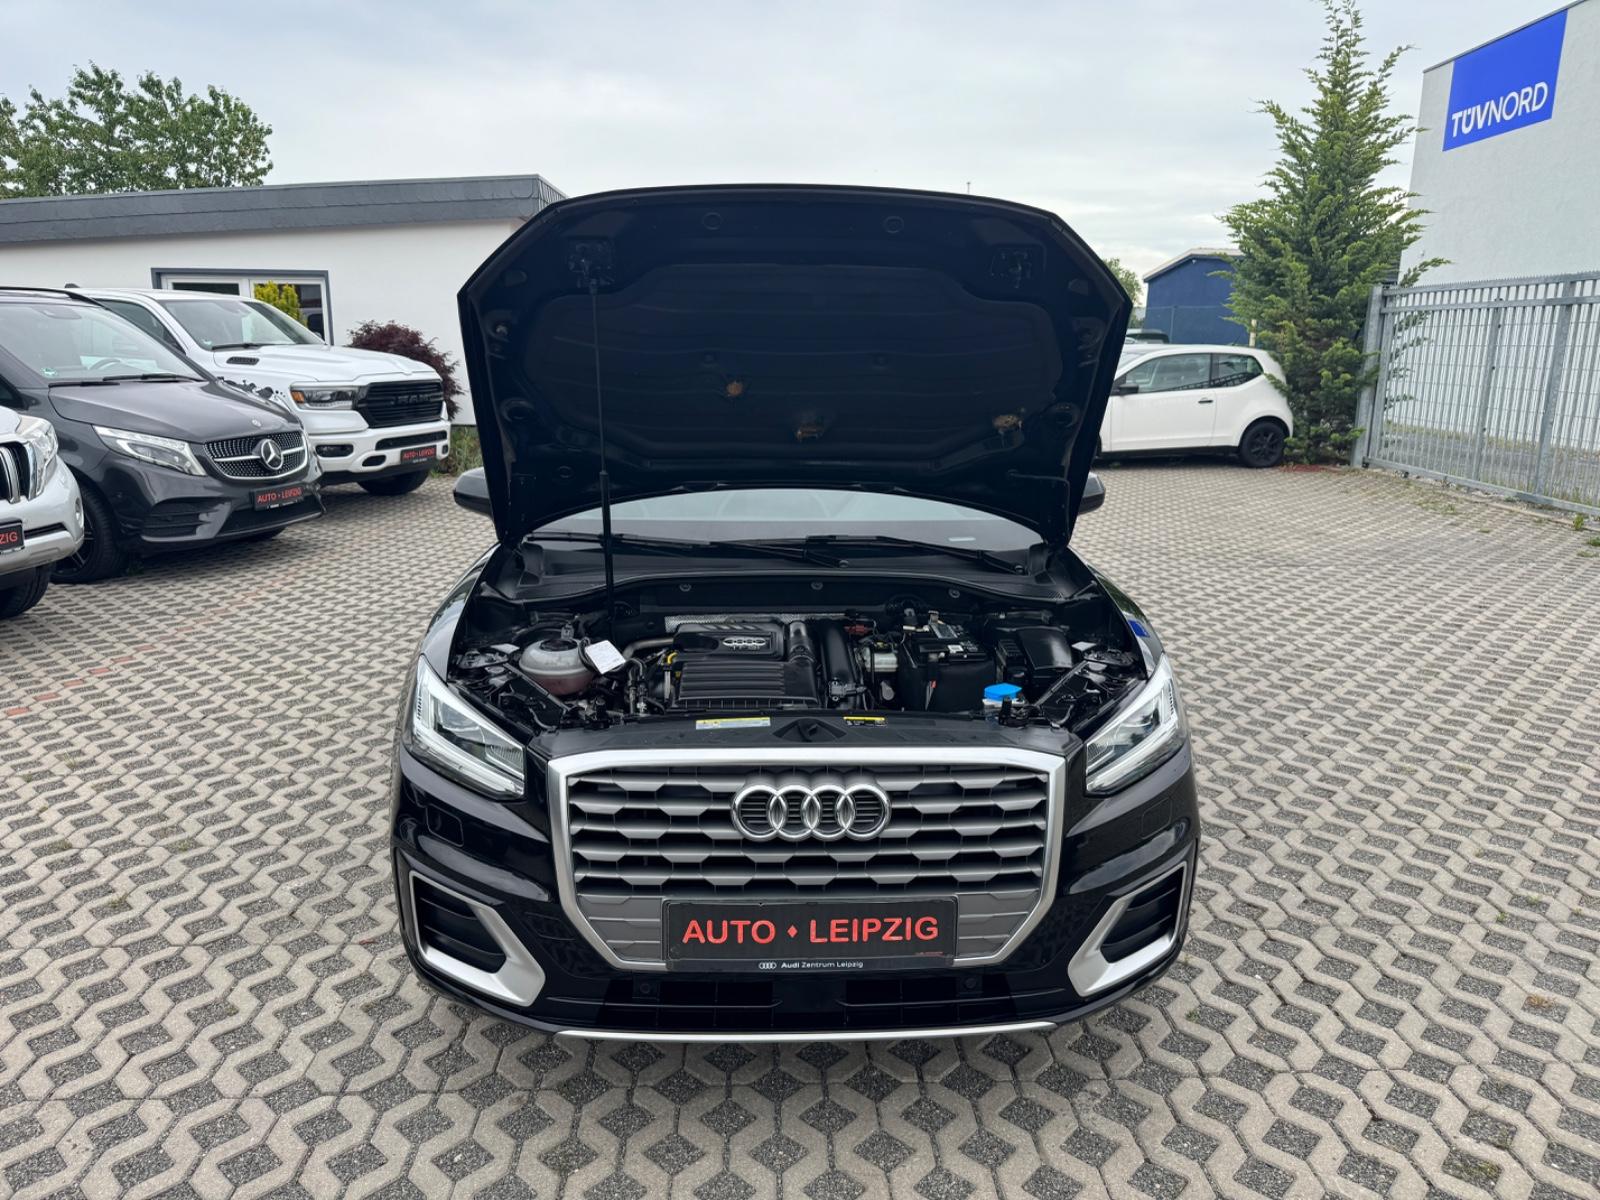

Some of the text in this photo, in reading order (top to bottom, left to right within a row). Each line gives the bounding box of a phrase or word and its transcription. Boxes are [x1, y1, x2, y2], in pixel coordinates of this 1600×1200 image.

[256, 487, 303, 504] AUTO LEIPZIG
[682, 916, 939, 944] AUTO LEIPZIG
[801, 961, 835, 969] Zentrum
[836, 961, 864, 969] Leipzig
